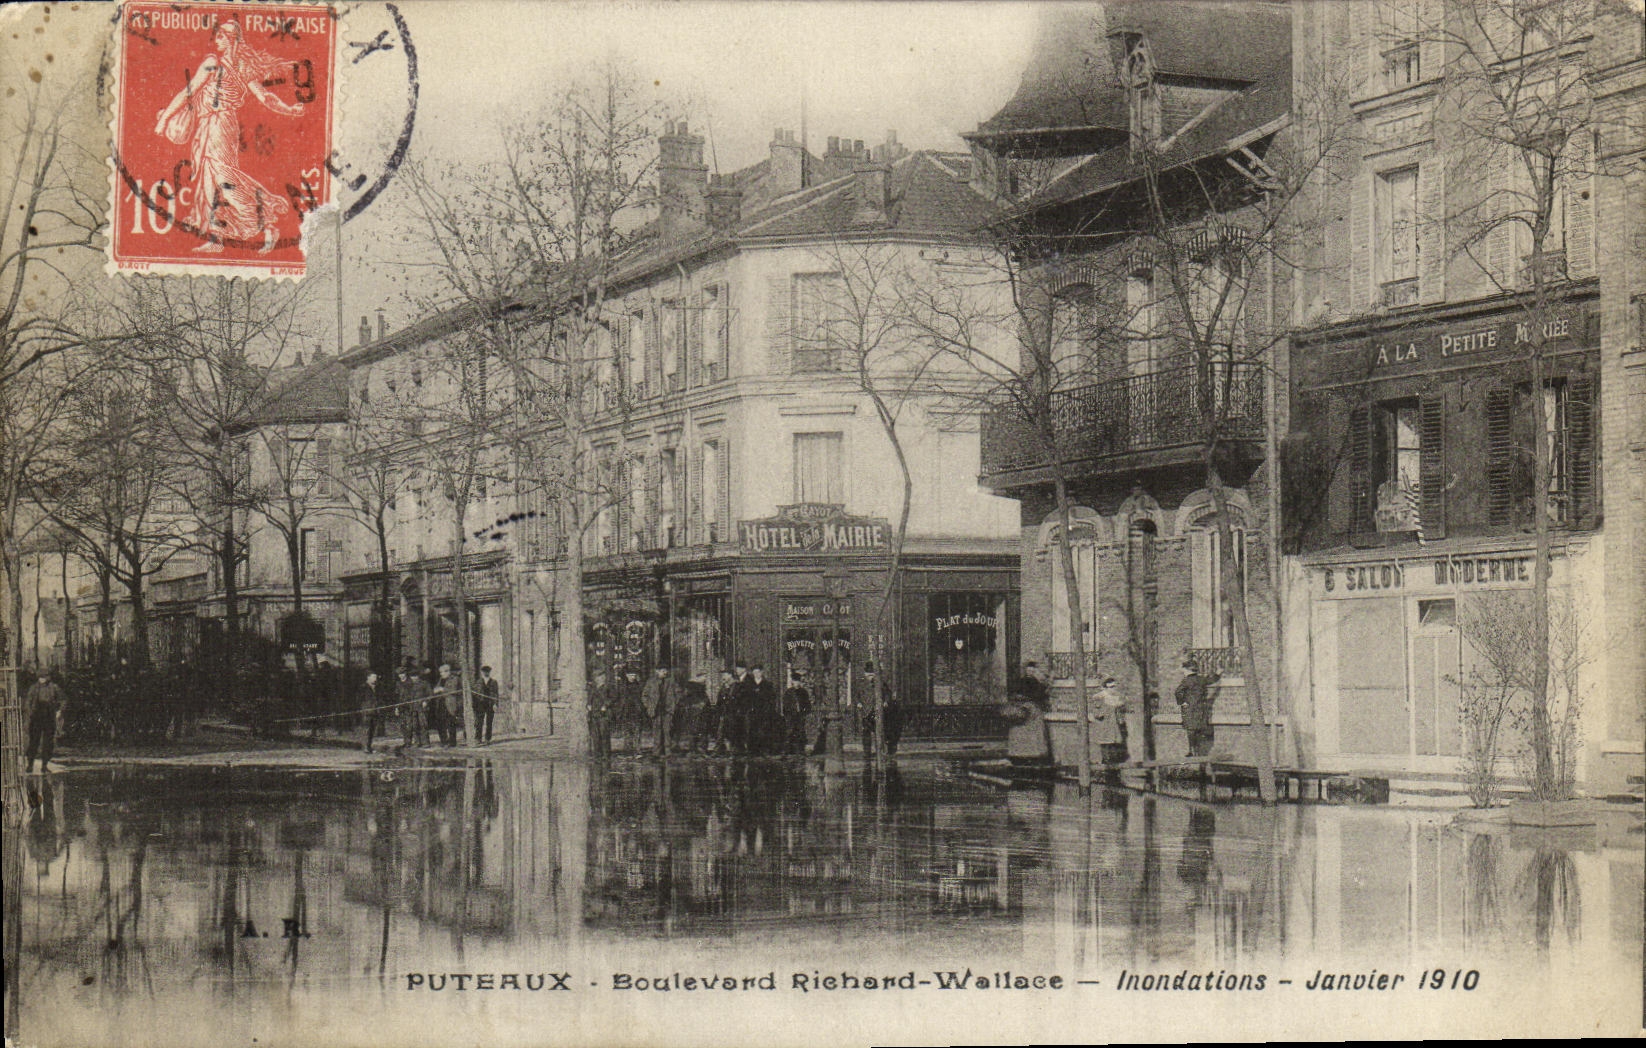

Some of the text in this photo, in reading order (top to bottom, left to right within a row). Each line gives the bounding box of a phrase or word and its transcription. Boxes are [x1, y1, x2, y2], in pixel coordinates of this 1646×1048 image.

[1440, 330, 1497, 357] PETITE
[1514, 317, 1569, 345] MIÉE
[821, 523, 883, 550] MAIRIE
[936, 614, 960, 631] PLAT
[787, 639, 816, 651] BUVETTE
